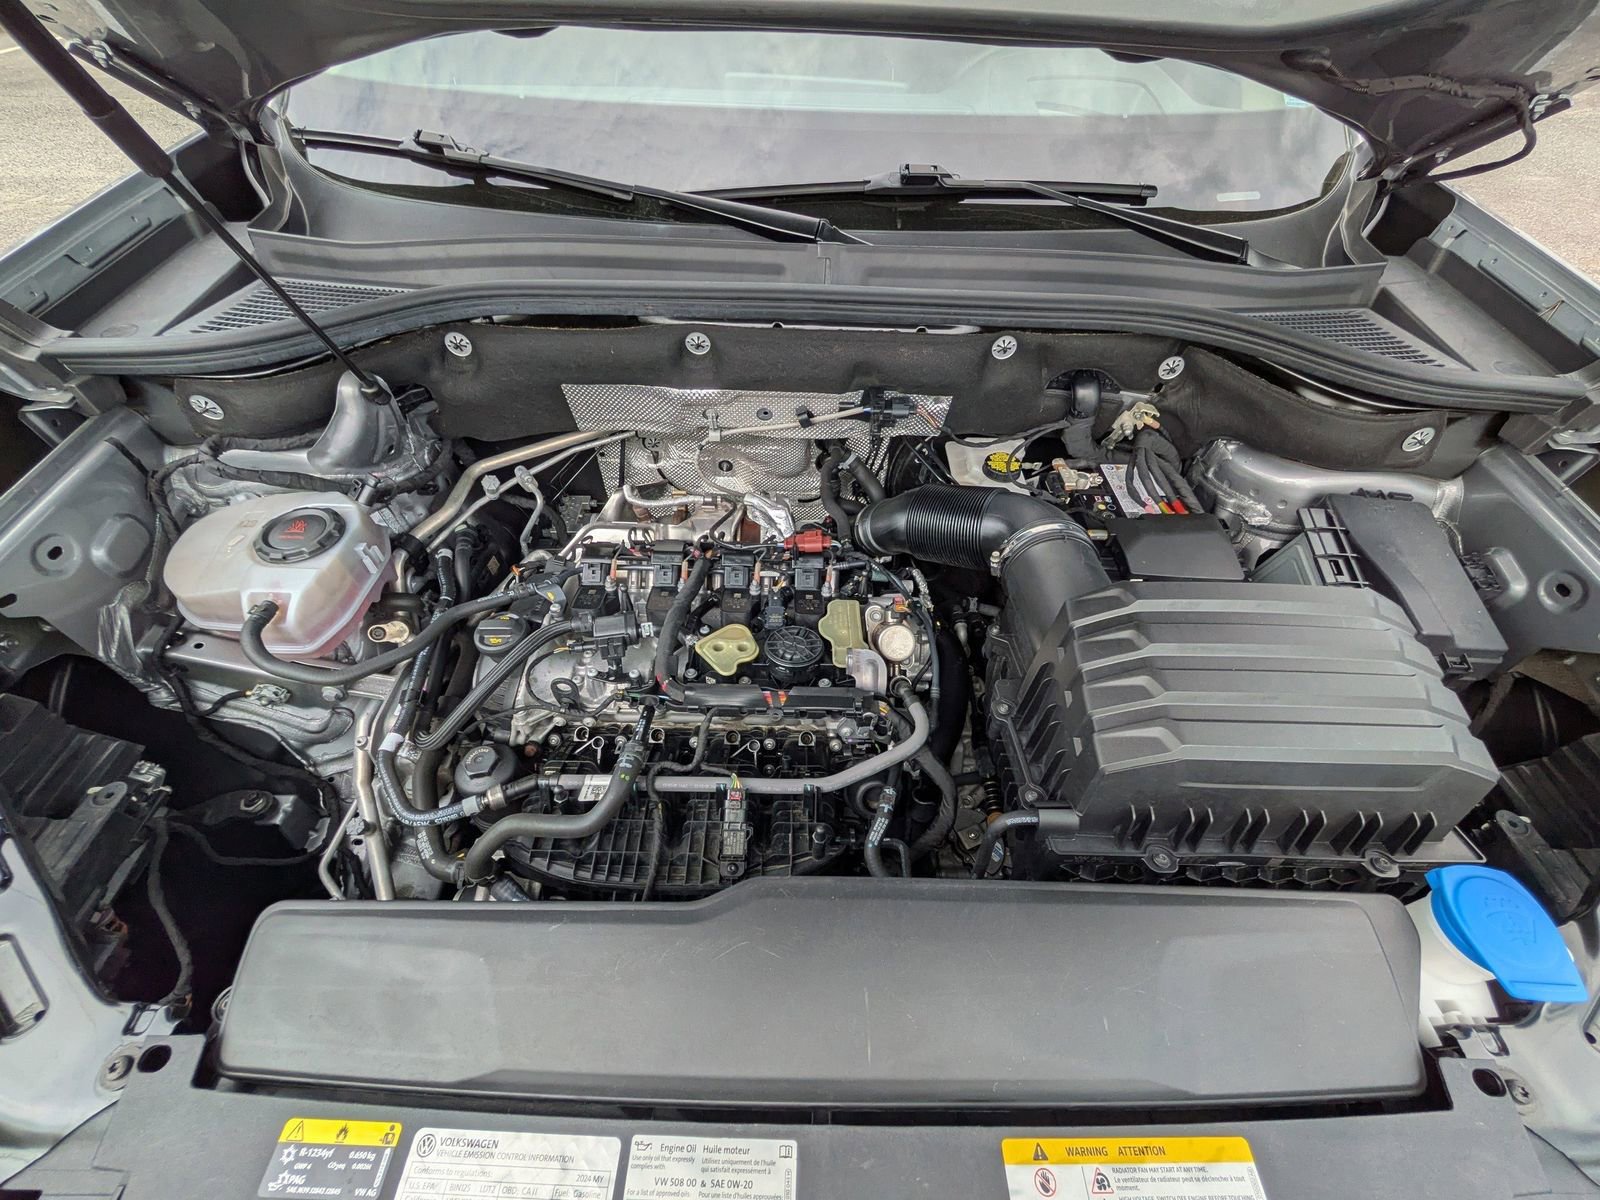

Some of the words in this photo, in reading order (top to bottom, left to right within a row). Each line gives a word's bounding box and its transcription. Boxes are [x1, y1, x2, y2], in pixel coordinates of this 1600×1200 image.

[440, 1136, 499, 1149] VOLKSWAGEN
[660, 1143, 684, 1155] Engine
[686, 1144, 696, 1154] Oil
[702, 1144, 722, 1154] Huile
[724, 1146, 750, 1155] moteur
[1065, 1146, 1108, 1156] WARNING
[1118, 1146, 1166, 1156] ATTENTION
[436, 1149, 462, 1158] VEHICLE
[463, 1150, 496, 1160] EMISSION
[496, 1152, 526, 1161] CONTROL
[528, 1152, 574, 1164] INFORMATION
[642, 1154, 654, 1163] only
[672, 1156, 696, 1164] expressly
[630, 1162, 653, 1171] complies
[722, 1158, 752, 1167] uniquement
[414, 1166, 444, 1175] Conforms
[731, 1166, 766, 1176] expressément
[576, 1174, 592, 1182] 2024
[593, 1175, 604, 1184] MY
[1202, 1174, 1230, 1182] déclencher
[654, 1177, 669, 1186] VW
[670, 1178, 684, 1188] 508
[686, 1178, 697, 1188] 00
[700, 1180, 706, 1188] &
[710, 1179, 725, 1188] SAE
[726, 1179, 754, 1190] 0W-20
[354, 1188, 368, 1196] VW
[366, 1188, 378, 1198] AG
[573, 1189, 602, 1199] Gasoline
[640, 1188, 648, 1196] list
[655, 1190, 680, 1198] approved
[698, 1190, 710, 1198] Pour
[721, 1191, 732, 1199] liste
